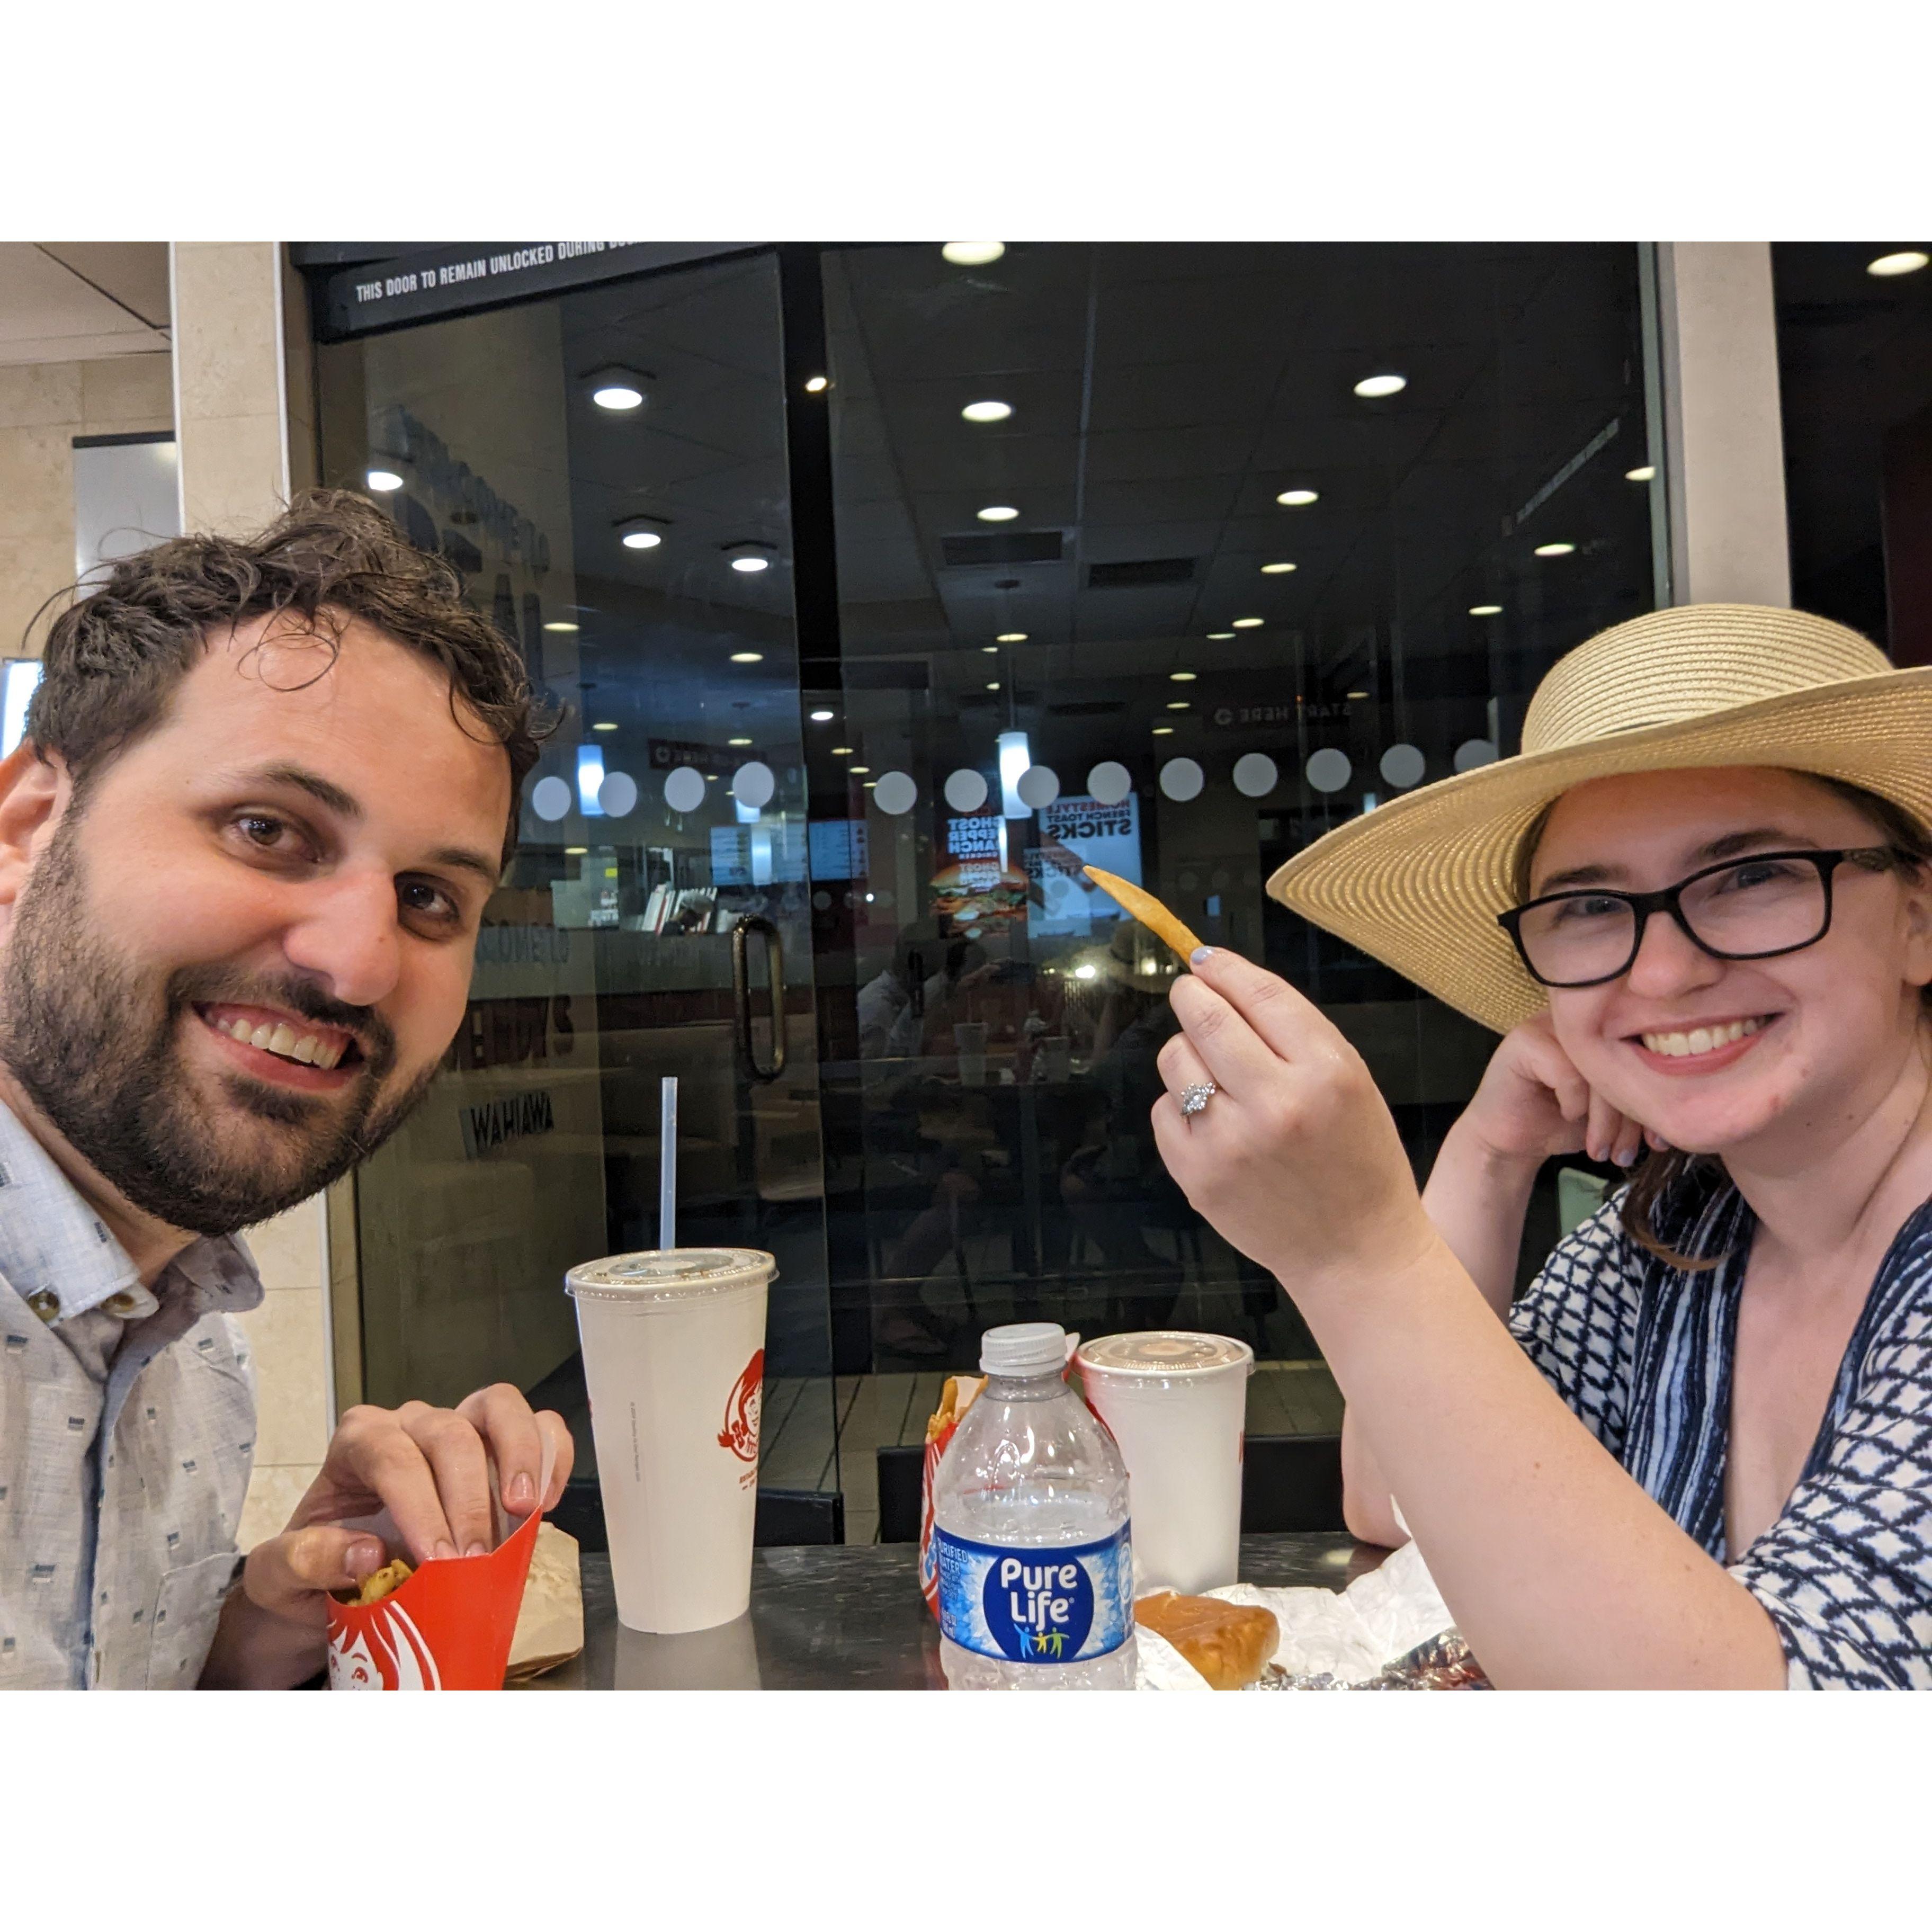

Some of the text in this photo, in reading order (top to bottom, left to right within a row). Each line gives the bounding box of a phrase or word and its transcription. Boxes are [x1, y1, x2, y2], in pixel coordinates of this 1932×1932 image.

[355, 241, 605, 303] THIS DOOR TO REMAIN UNLOCKED DURING
[1001, 1558, 1078, 1590] Pure
[1010, 1590, 1069, 1632] Life
